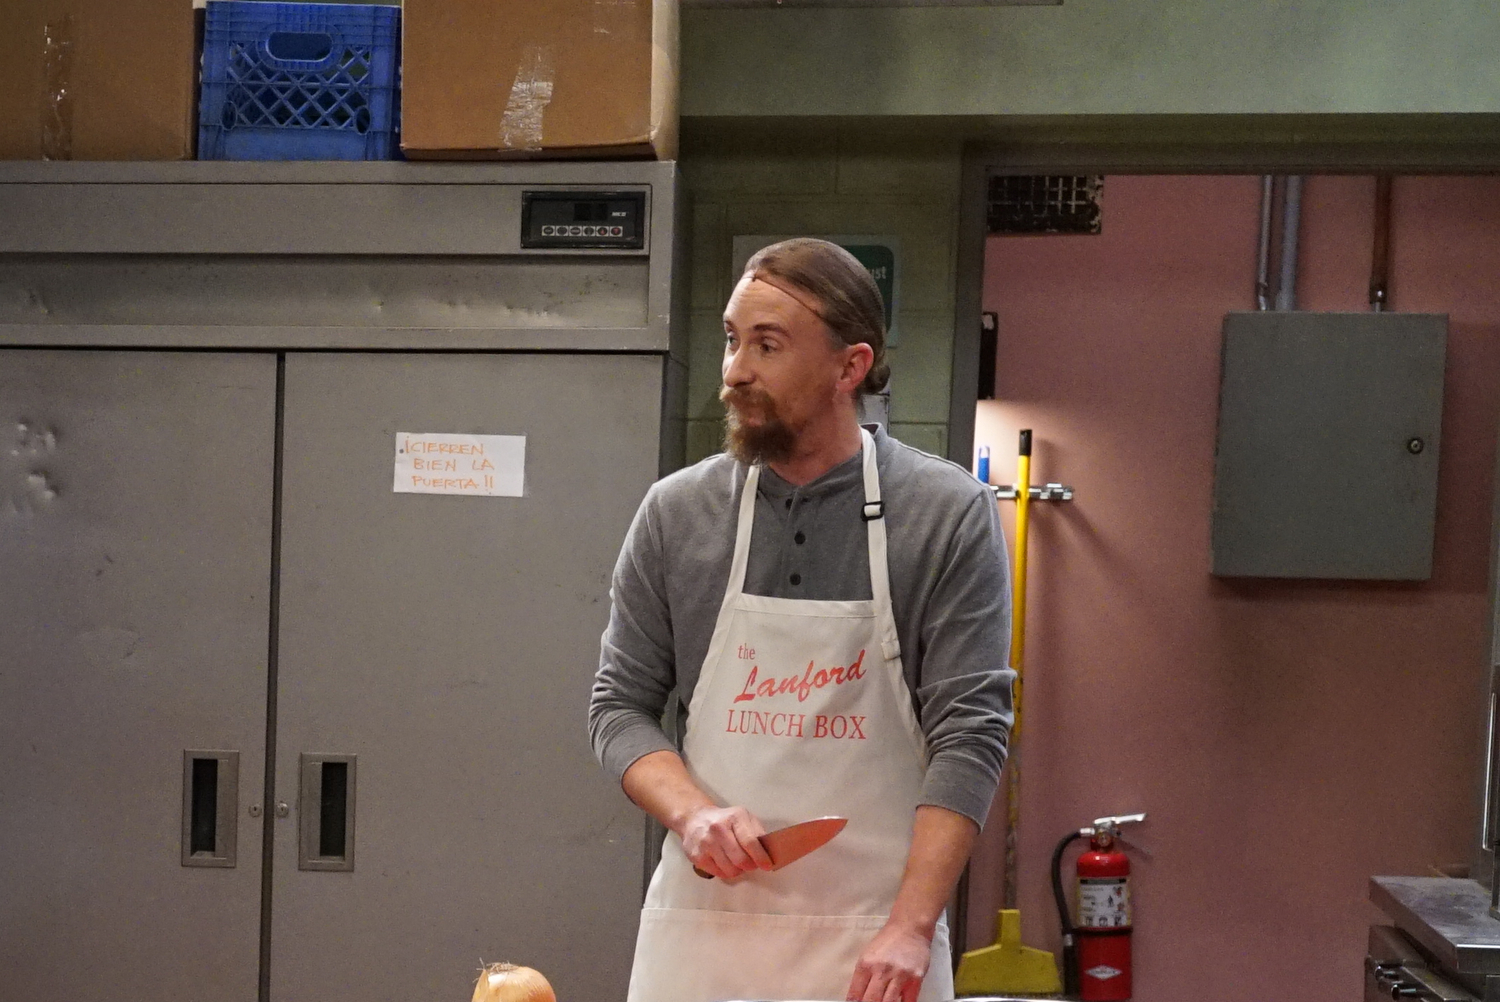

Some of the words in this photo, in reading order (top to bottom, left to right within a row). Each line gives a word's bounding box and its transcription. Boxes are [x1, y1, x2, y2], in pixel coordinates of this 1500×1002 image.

[413, 458, 456, 472] BIEN
[472, 459, 495, 471] LA
[738, 643, 756, 660] the
[733, 649, 867, 703] Lanford
[726, 709, 805, 738] LUNCH
[813, 715, 867, 739] BOX
